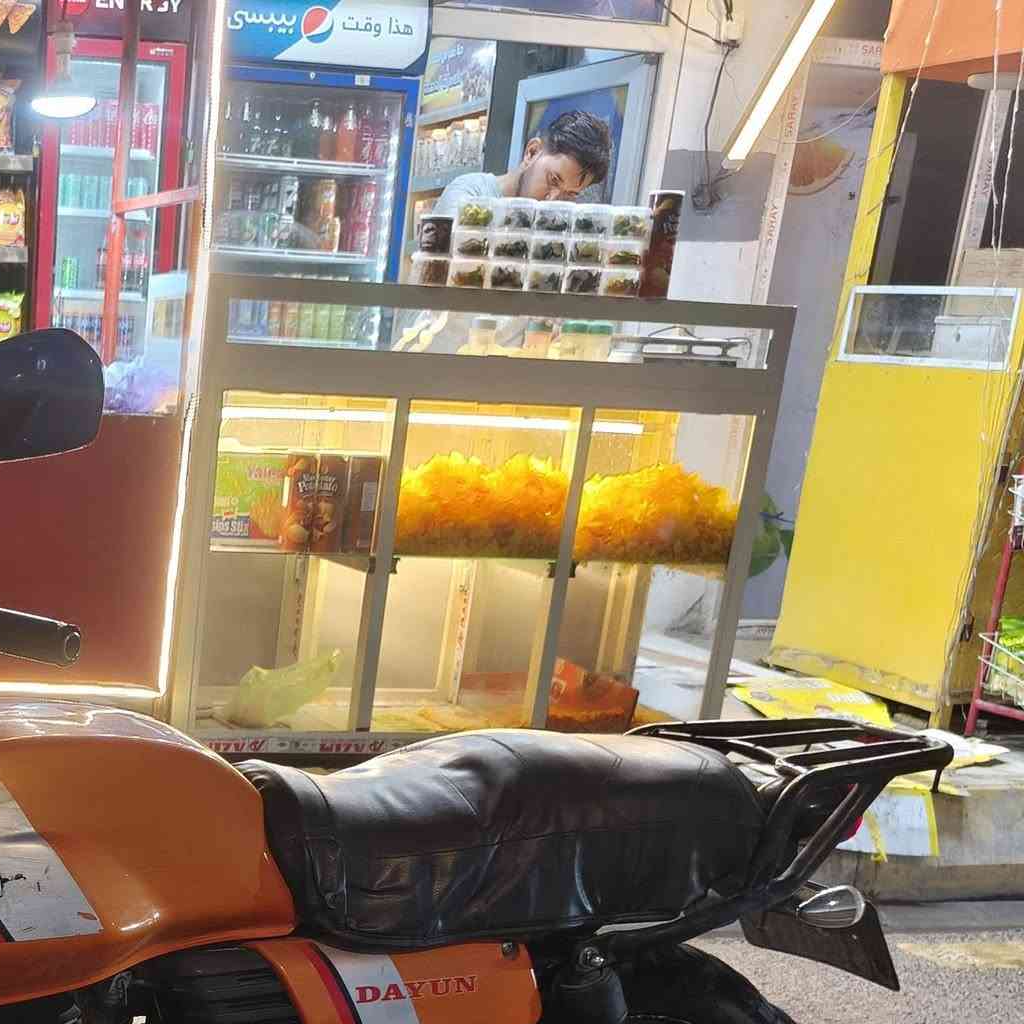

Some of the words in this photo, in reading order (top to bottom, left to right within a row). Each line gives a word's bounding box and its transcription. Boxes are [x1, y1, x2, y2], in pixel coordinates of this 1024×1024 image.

[342, 16, 381, 37] وقت
[389, 17, 414, 36] هذا
[355, 975, 477, 1004] DAYUN
